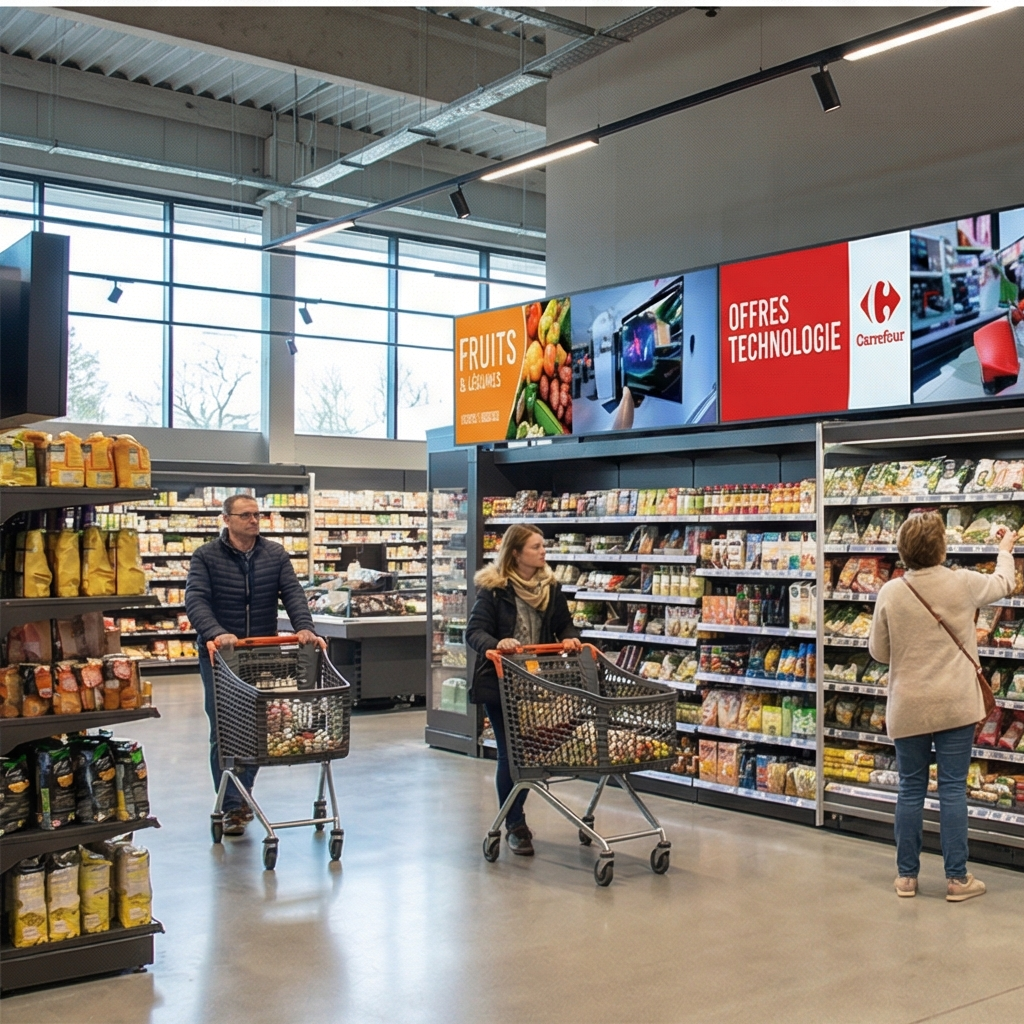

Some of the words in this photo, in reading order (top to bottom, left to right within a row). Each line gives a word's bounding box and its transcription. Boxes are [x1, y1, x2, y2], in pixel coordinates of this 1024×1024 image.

[728, 294, 790, 332] OFFRES
[459, 329, 517, 372] FRUITS
[727, 320, 842, 364] TECHNOLOGIE
